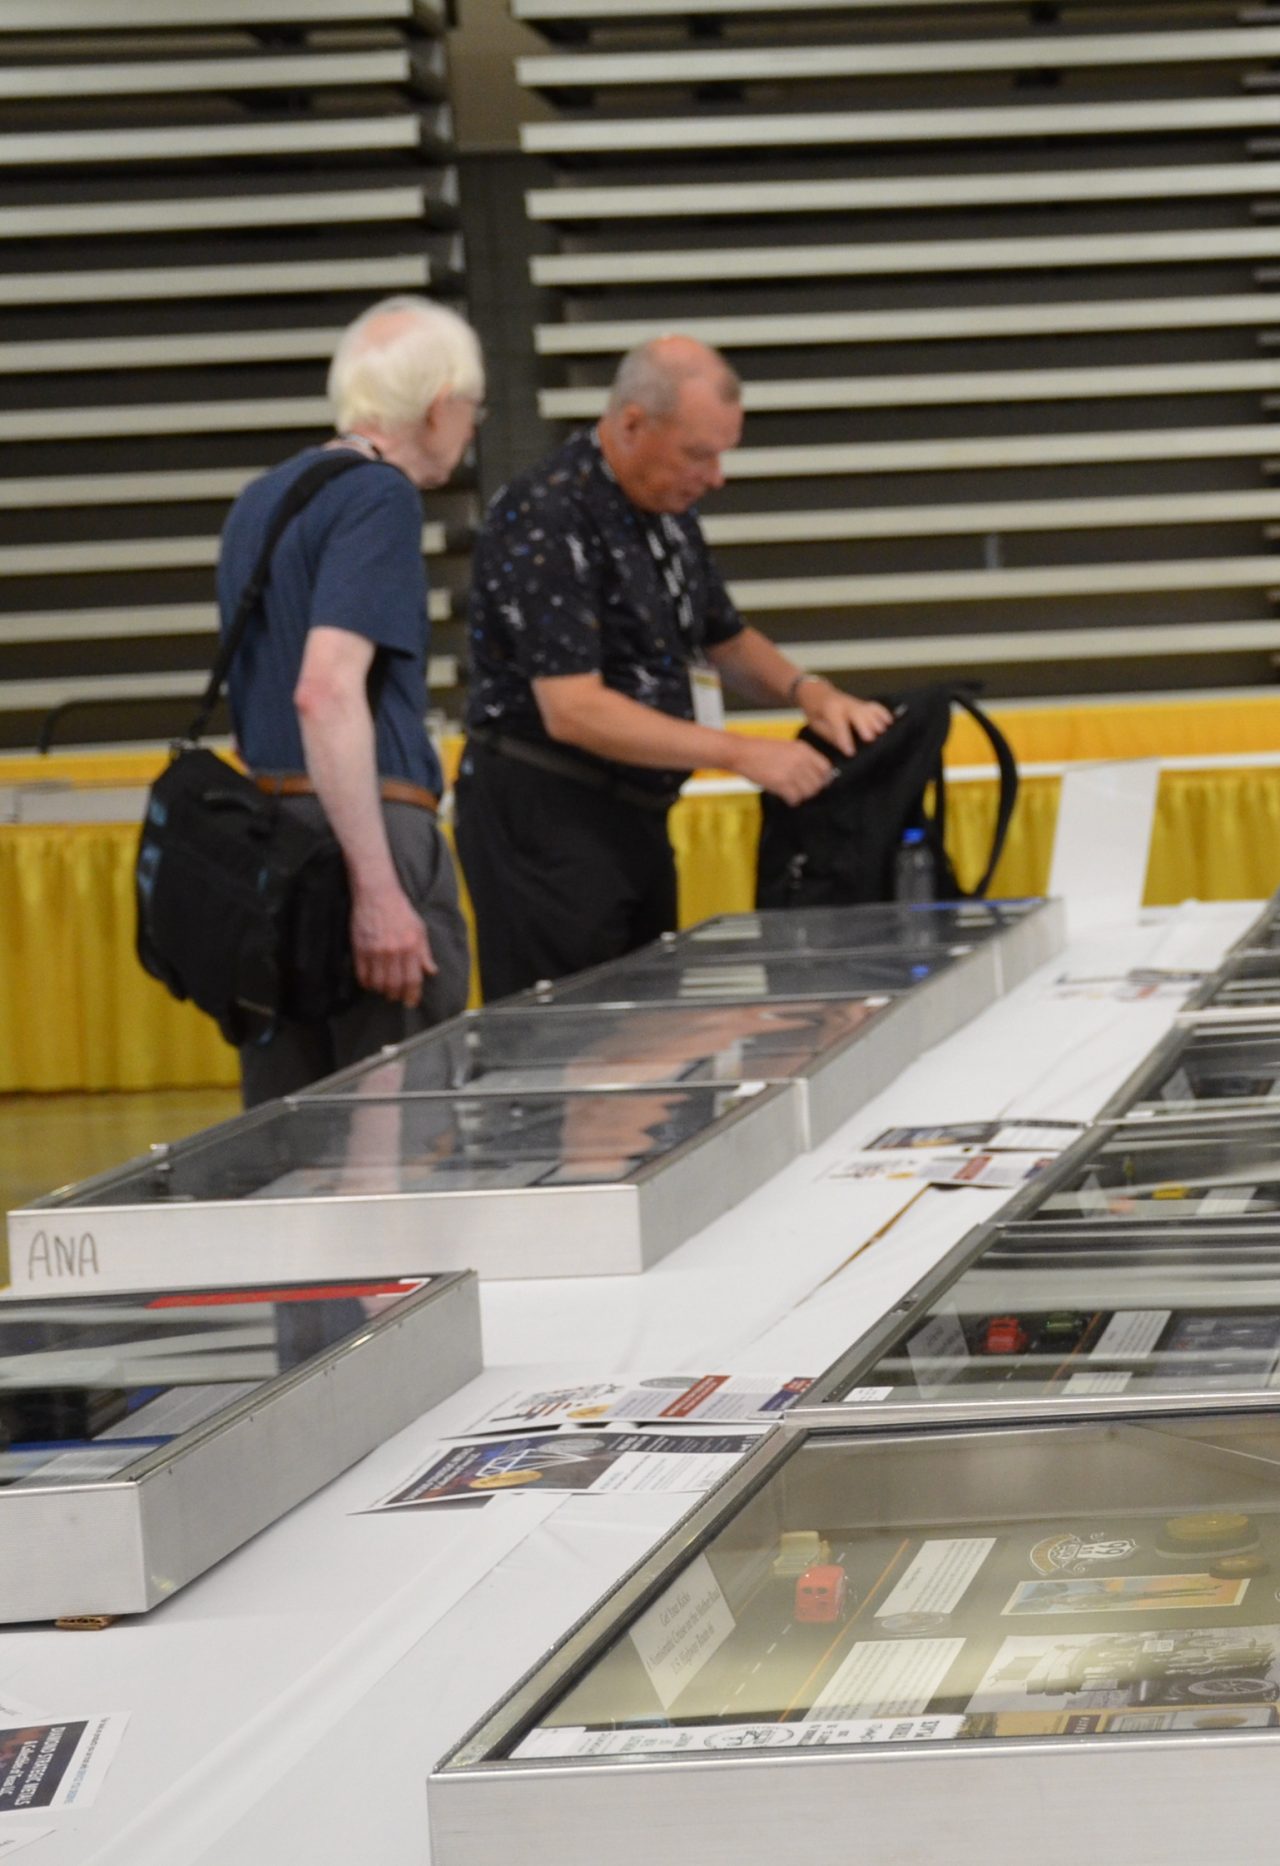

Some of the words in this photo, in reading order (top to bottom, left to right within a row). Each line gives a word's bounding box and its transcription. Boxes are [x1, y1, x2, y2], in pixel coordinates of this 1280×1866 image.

[28, 1230, 99, 1281] ANA
[1096, 1541, 1126, 1555] 66
[914, 1720, 940, 1738] PLACE
[25, 1753, 54, 1783] STRATEGIC
[14, 1782, 40, 1806] METALS
